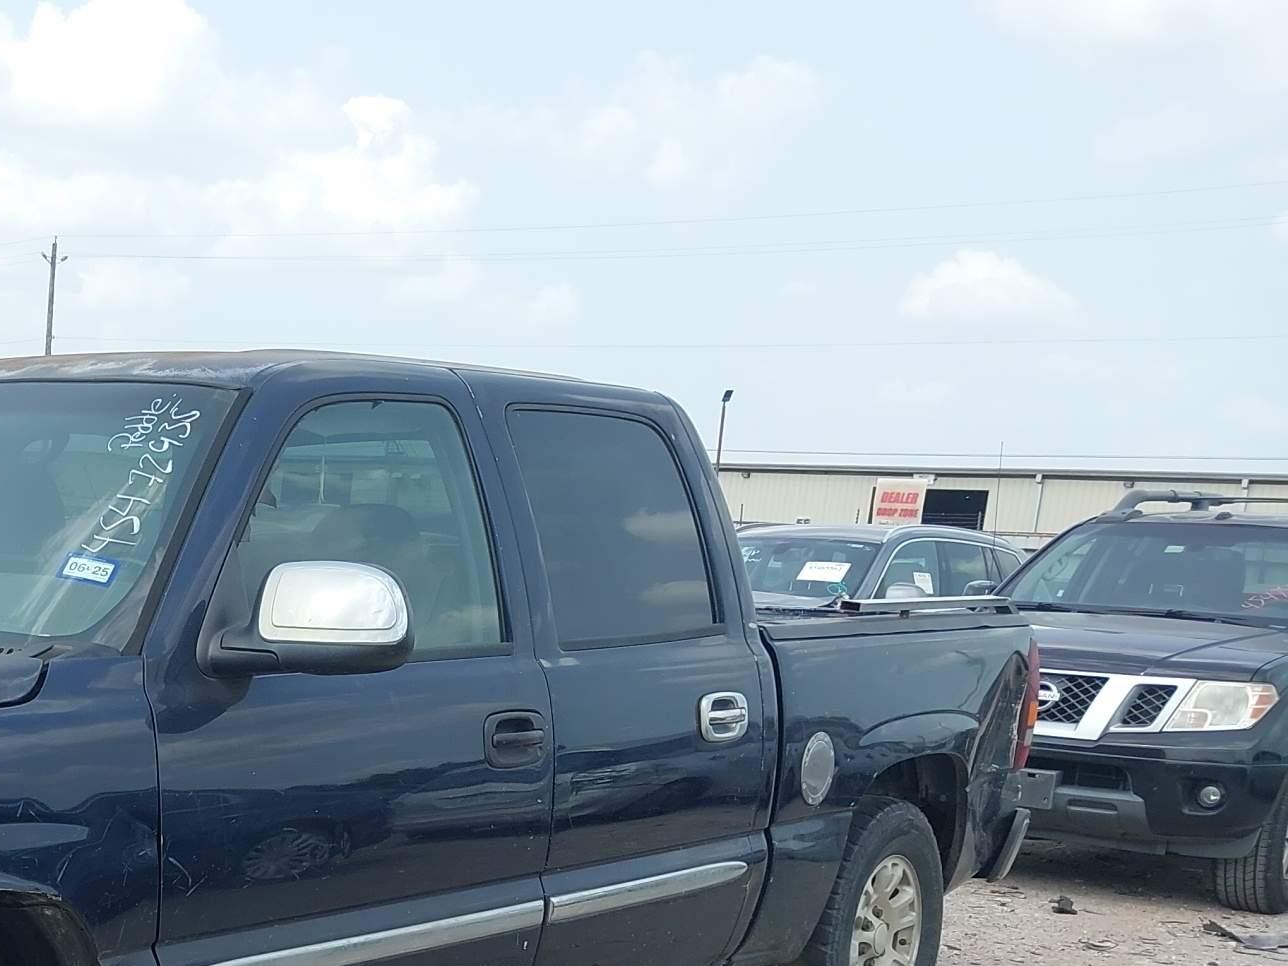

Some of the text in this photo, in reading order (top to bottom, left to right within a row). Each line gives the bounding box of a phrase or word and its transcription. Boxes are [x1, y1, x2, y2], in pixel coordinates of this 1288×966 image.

[81, 397, 201, 554] 45472935
[880, 491, 918, 505] DEALER
[91, 565, 111, 577] 25
